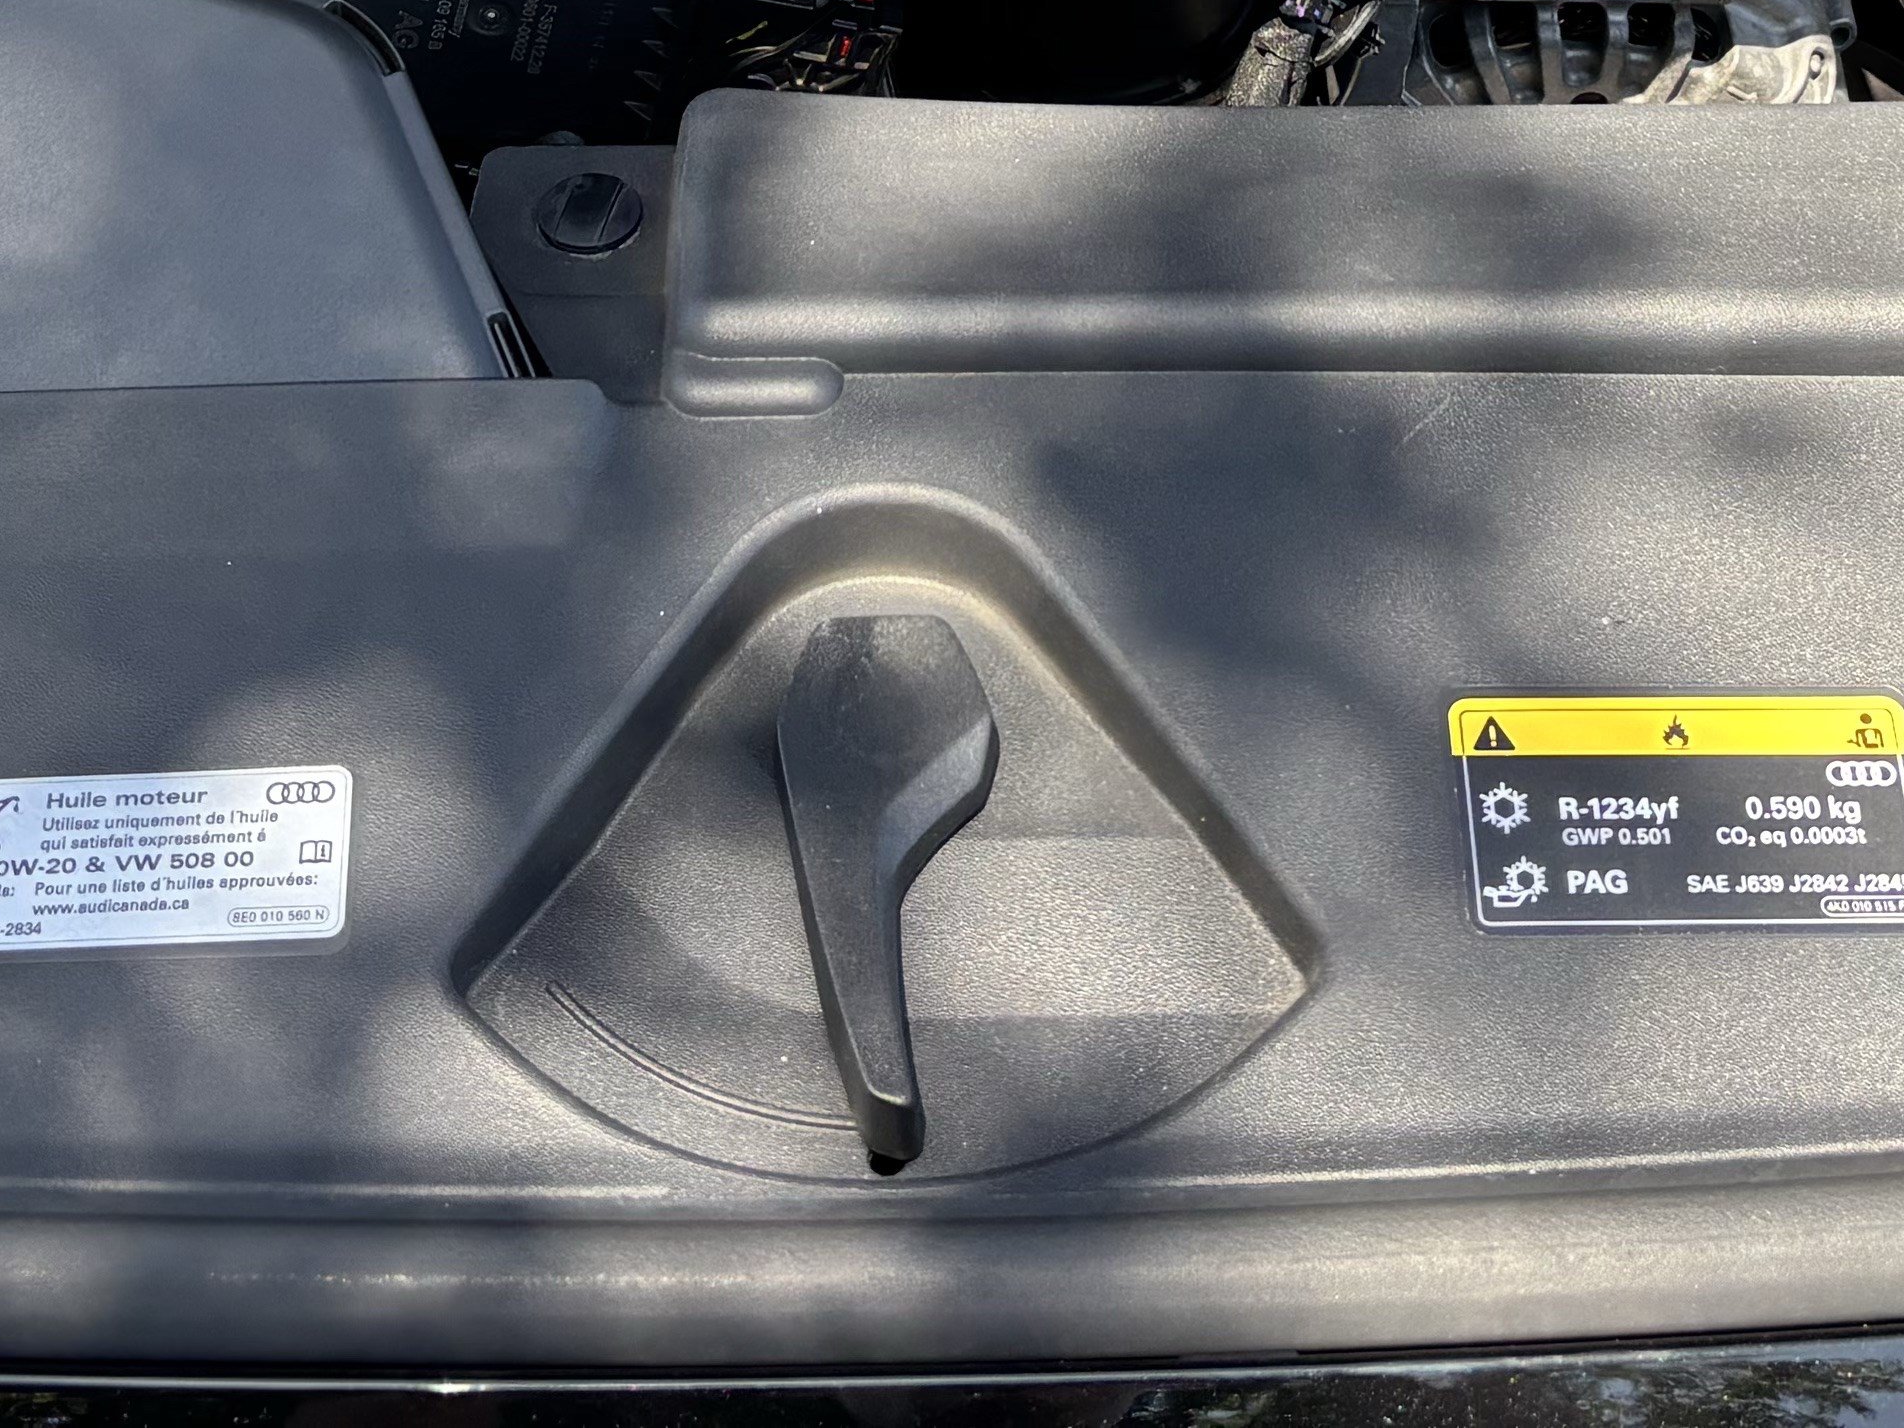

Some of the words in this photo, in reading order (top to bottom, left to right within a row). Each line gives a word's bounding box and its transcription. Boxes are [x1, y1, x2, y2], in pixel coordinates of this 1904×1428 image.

[395, 10, 423, 49] AG
[46, 791, 106, 809] Huile
[116, 790, 208, 806] moteur
[1558, 796, 1679, 824] R-1234yf
[1746, 796, 1821, 820] 0.590
[1828, 795, 1862, 824] kg
[42, 816, 99, 832] Utilisez
[105, 814, 201, 830] uniquement
[206, 812, 225, 824] de
[40, 836, 66, 853] qui
[71, 834, 134, 850] satisfait
[138, 832, 252, 848] expressément
[1562, 828, 1614, 846] GWP
[1618, 828, 1671, 845] 0.501
[1760, 830, 1787, 847] eq
[1790, 826, 1867, 845] 0.0003t
[86, 856, 105, 873] &
[115, 854, 162, 872] VW
[170, 852, 215, 869] 508
[224, 851, 254, 867] 00
[36, 882, 72, 895] Pour
[77, 882, 106, 894] une
[113, 878, 145, 893] liste
[219, 874, 318, 890] approuvées:
[1567, 869, 1628, 894] PAG
[1687, 874, 1730, 893] SAE
[1735, 875, 1784, 893] J639
[1789, 874, 1849, 893] J2842
[32, 898, 189, 916] www.audicanada.ca
[232, 911, 256, 923] 8E0
[261, 911, 283, 922] 010
[316, 909, 325, 920] N
[1852, 901, 1872, 911] 010
